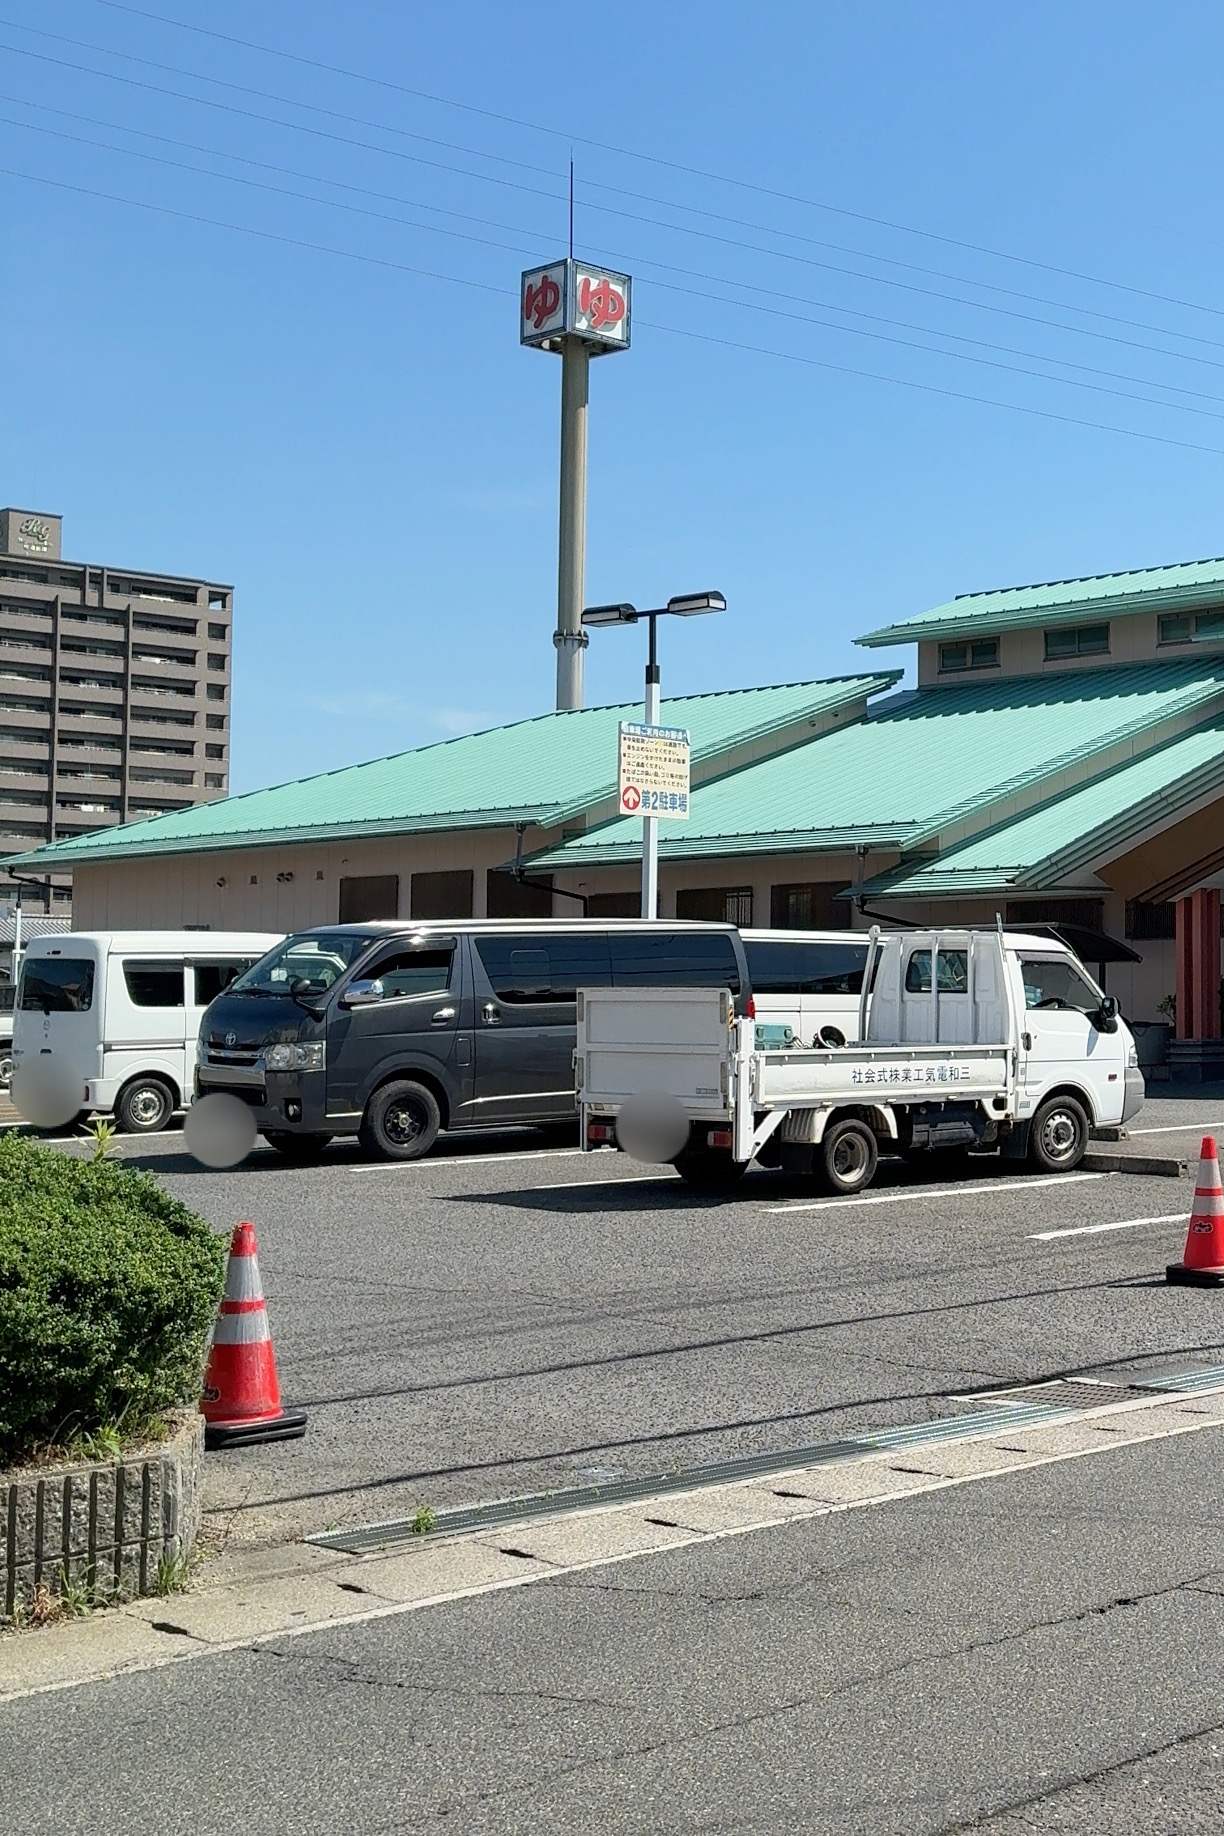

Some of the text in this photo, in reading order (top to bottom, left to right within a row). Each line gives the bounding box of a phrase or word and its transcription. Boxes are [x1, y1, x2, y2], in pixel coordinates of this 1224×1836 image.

[525, 274, 560, 329] ゆ
[579, 276, 626, 330] ゆ
[641, 789, 688, 812] 第2駐車場
